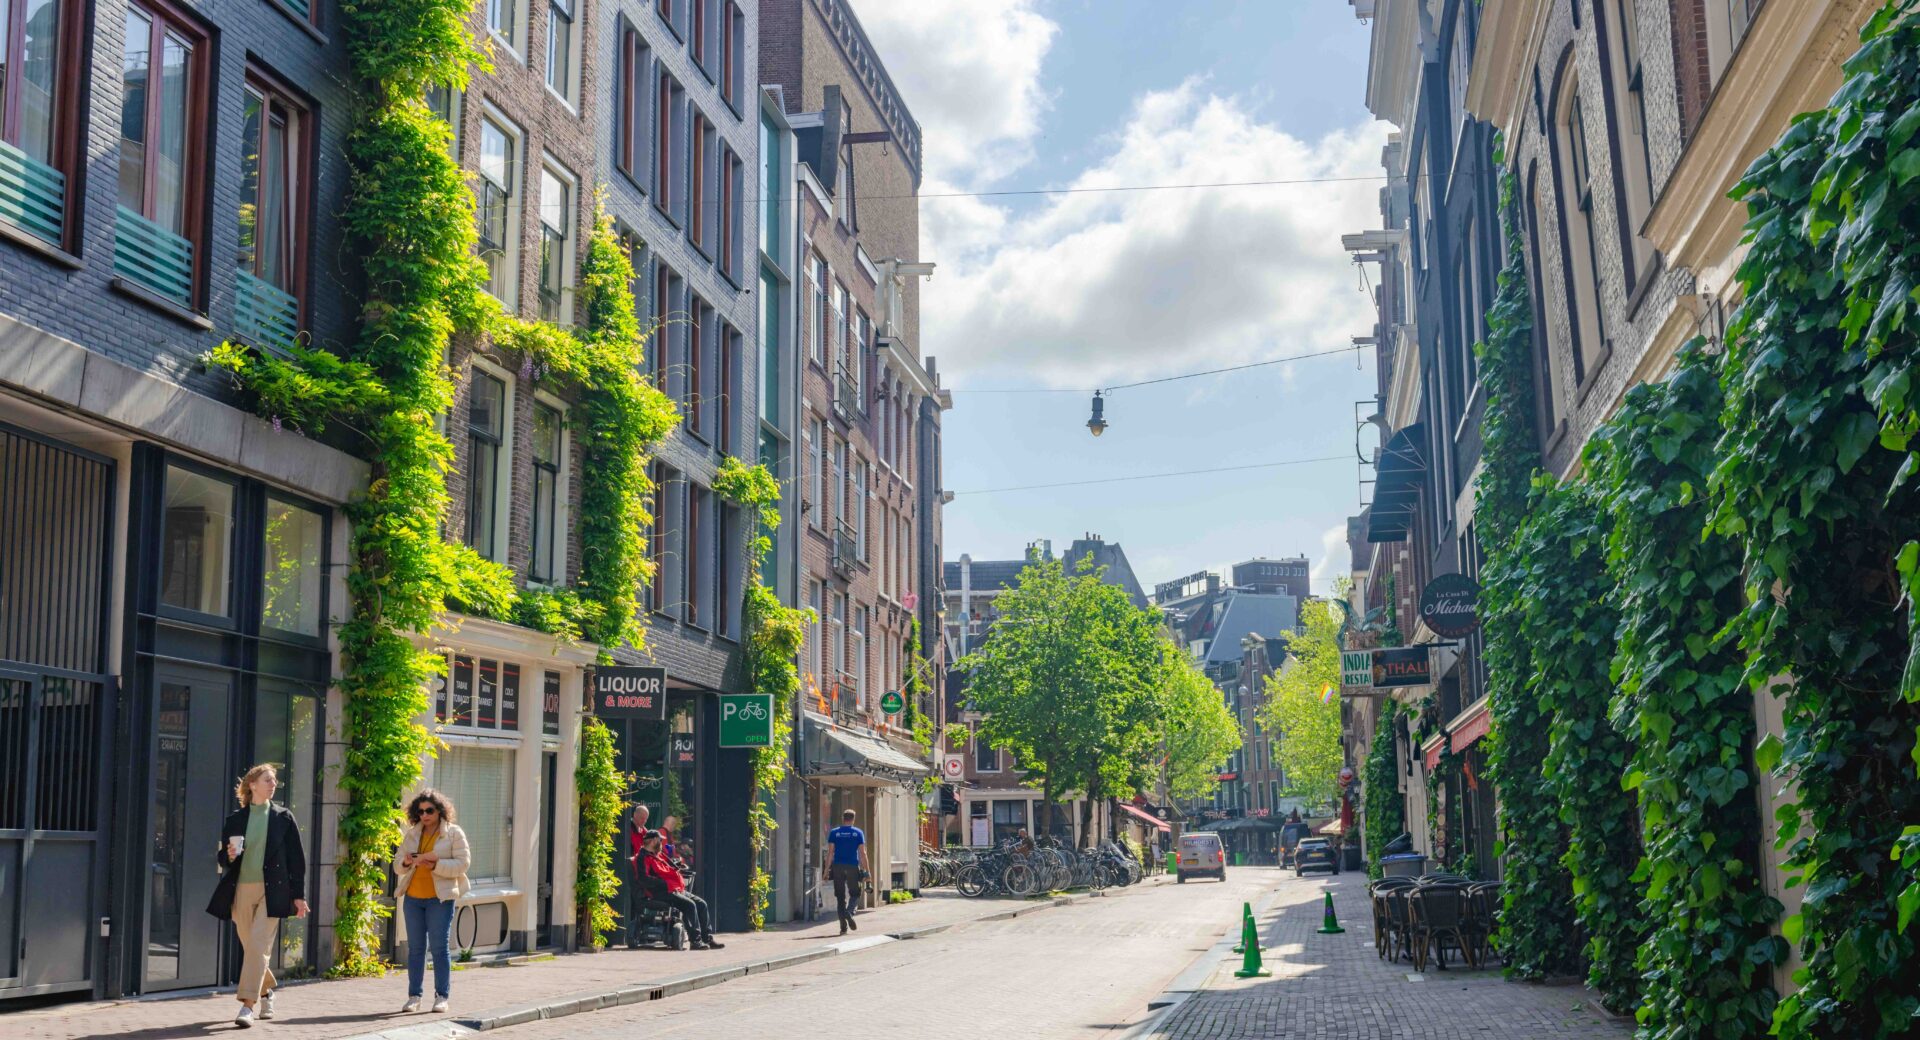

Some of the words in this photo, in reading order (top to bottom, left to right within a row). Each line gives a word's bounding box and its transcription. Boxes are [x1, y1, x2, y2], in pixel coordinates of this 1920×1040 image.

[1386, 660, 1429, 675] THALI
[504, 687, 514, 697] COLD
[599, 676, 660, 694] LIQUOR
[605, 695, 616, 707] &
[617, 695, 652, 708] MORE
[723, 702, 737, 721] P
[745, 735, 767, 743] OPEN
